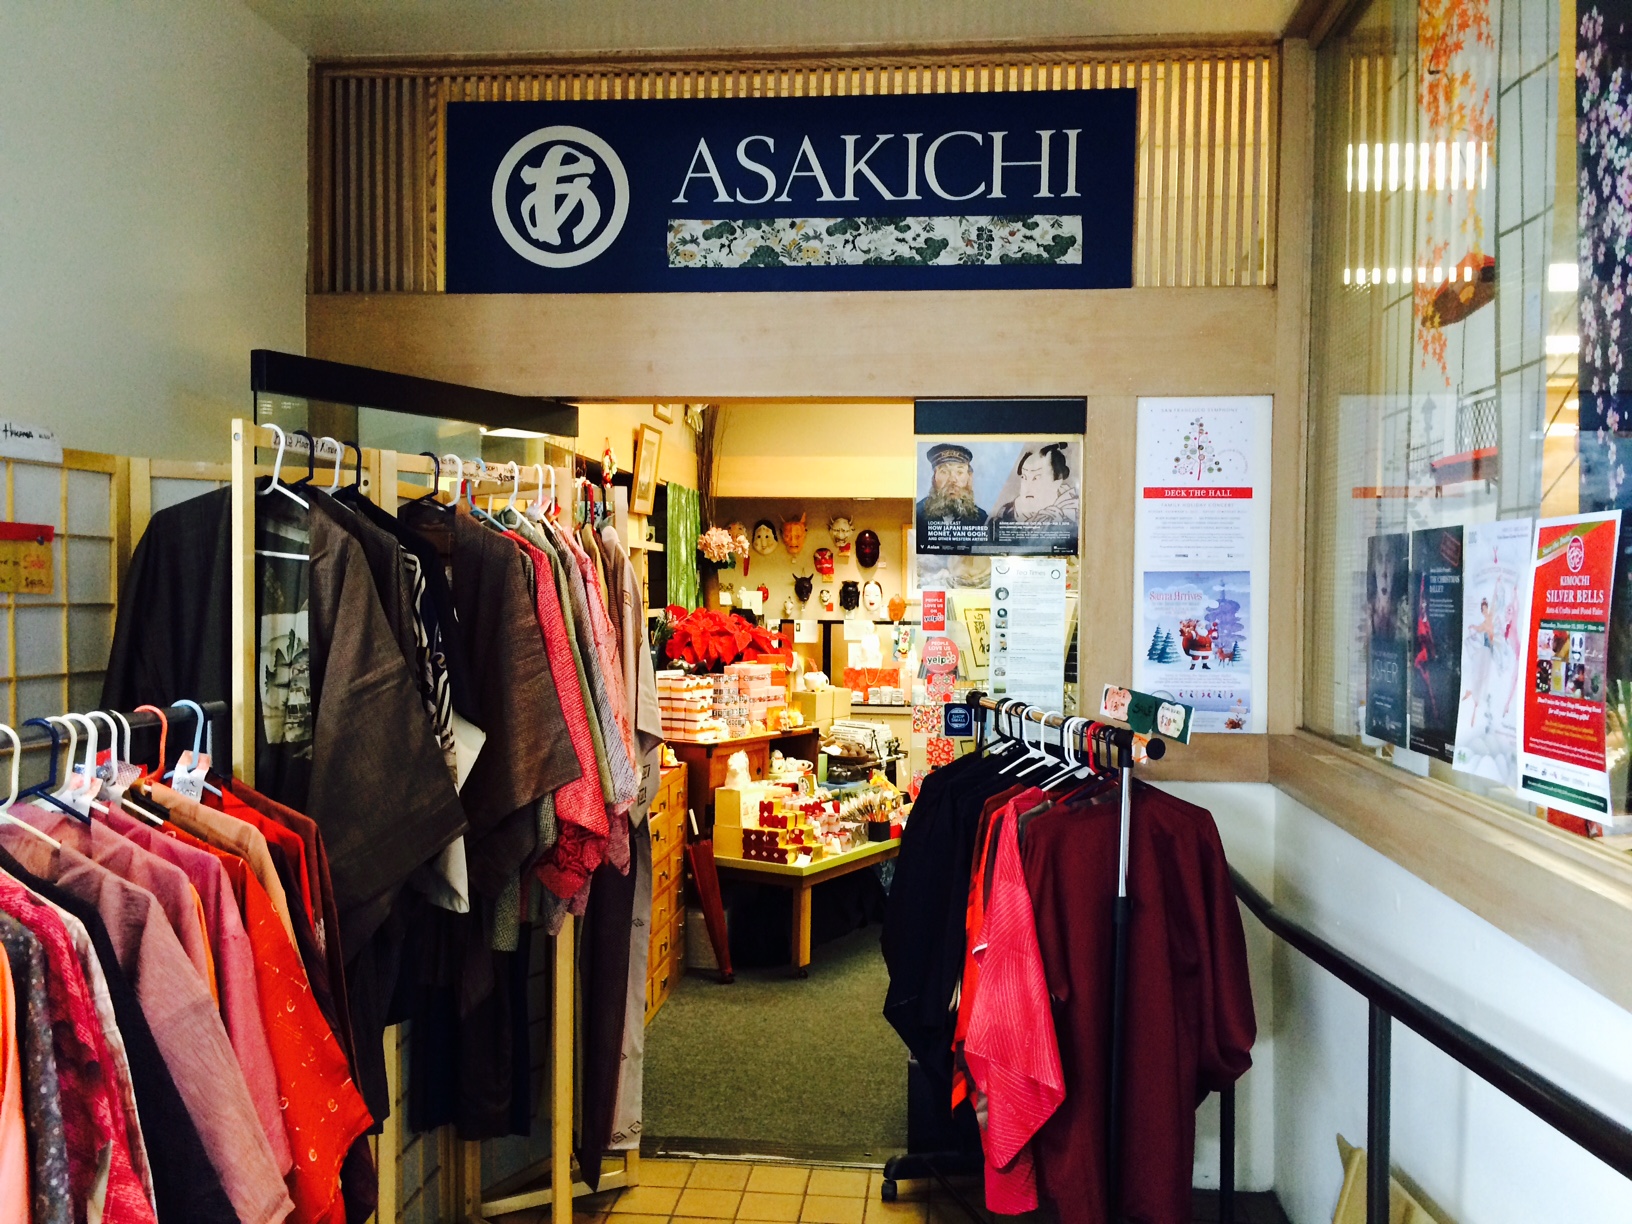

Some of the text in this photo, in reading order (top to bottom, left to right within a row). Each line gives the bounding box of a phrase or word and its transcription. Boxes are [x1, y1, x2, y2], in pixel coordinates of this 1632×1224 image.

[671, 128, 1083, 204] ASAKICHI
[1164, 489, 1187, 497] DECK
[1208, 489, 1233, 497] HALL
[1560, 575, 1590, 586] KIMOCHI
[1149, 590, 1203, 601] Santa Arrives
[1546, 589, 1604, 604] SILVER BELLS
[926, 655, 947, 665] yelp
